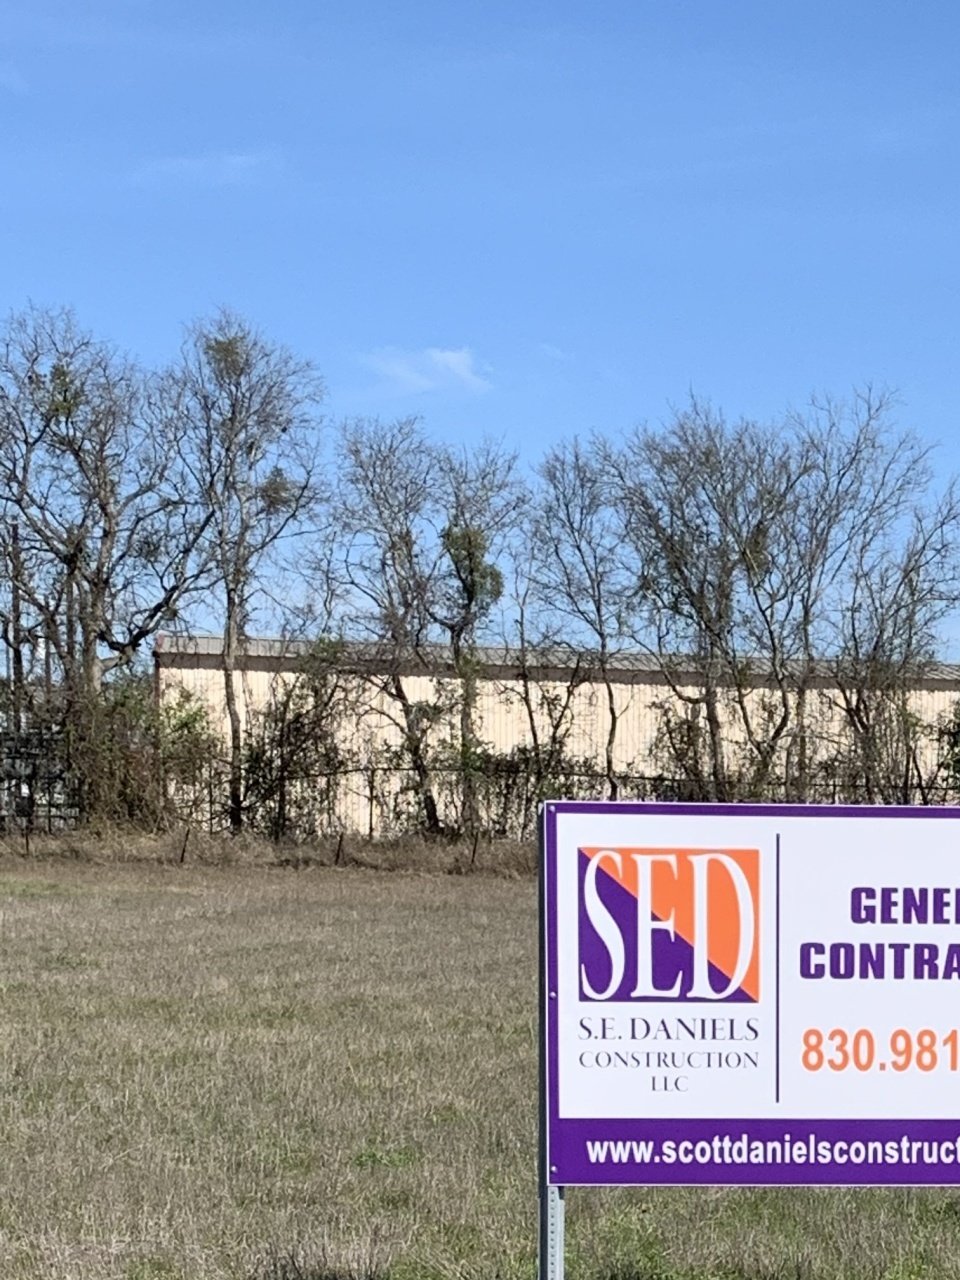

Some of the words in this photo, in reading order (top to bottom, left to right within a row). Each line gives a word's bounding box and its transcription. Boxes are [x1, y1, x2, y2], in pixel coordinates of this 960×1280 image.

[580, 849, 755, 1000] SED
[578, 1016, 622, 1041] S.E.
[630, 1017, 760, 1041] DANIELS
[578, 1051, 759, 1068] CONSTRUCTION
[651, 1075, 689, 1092] LLC
